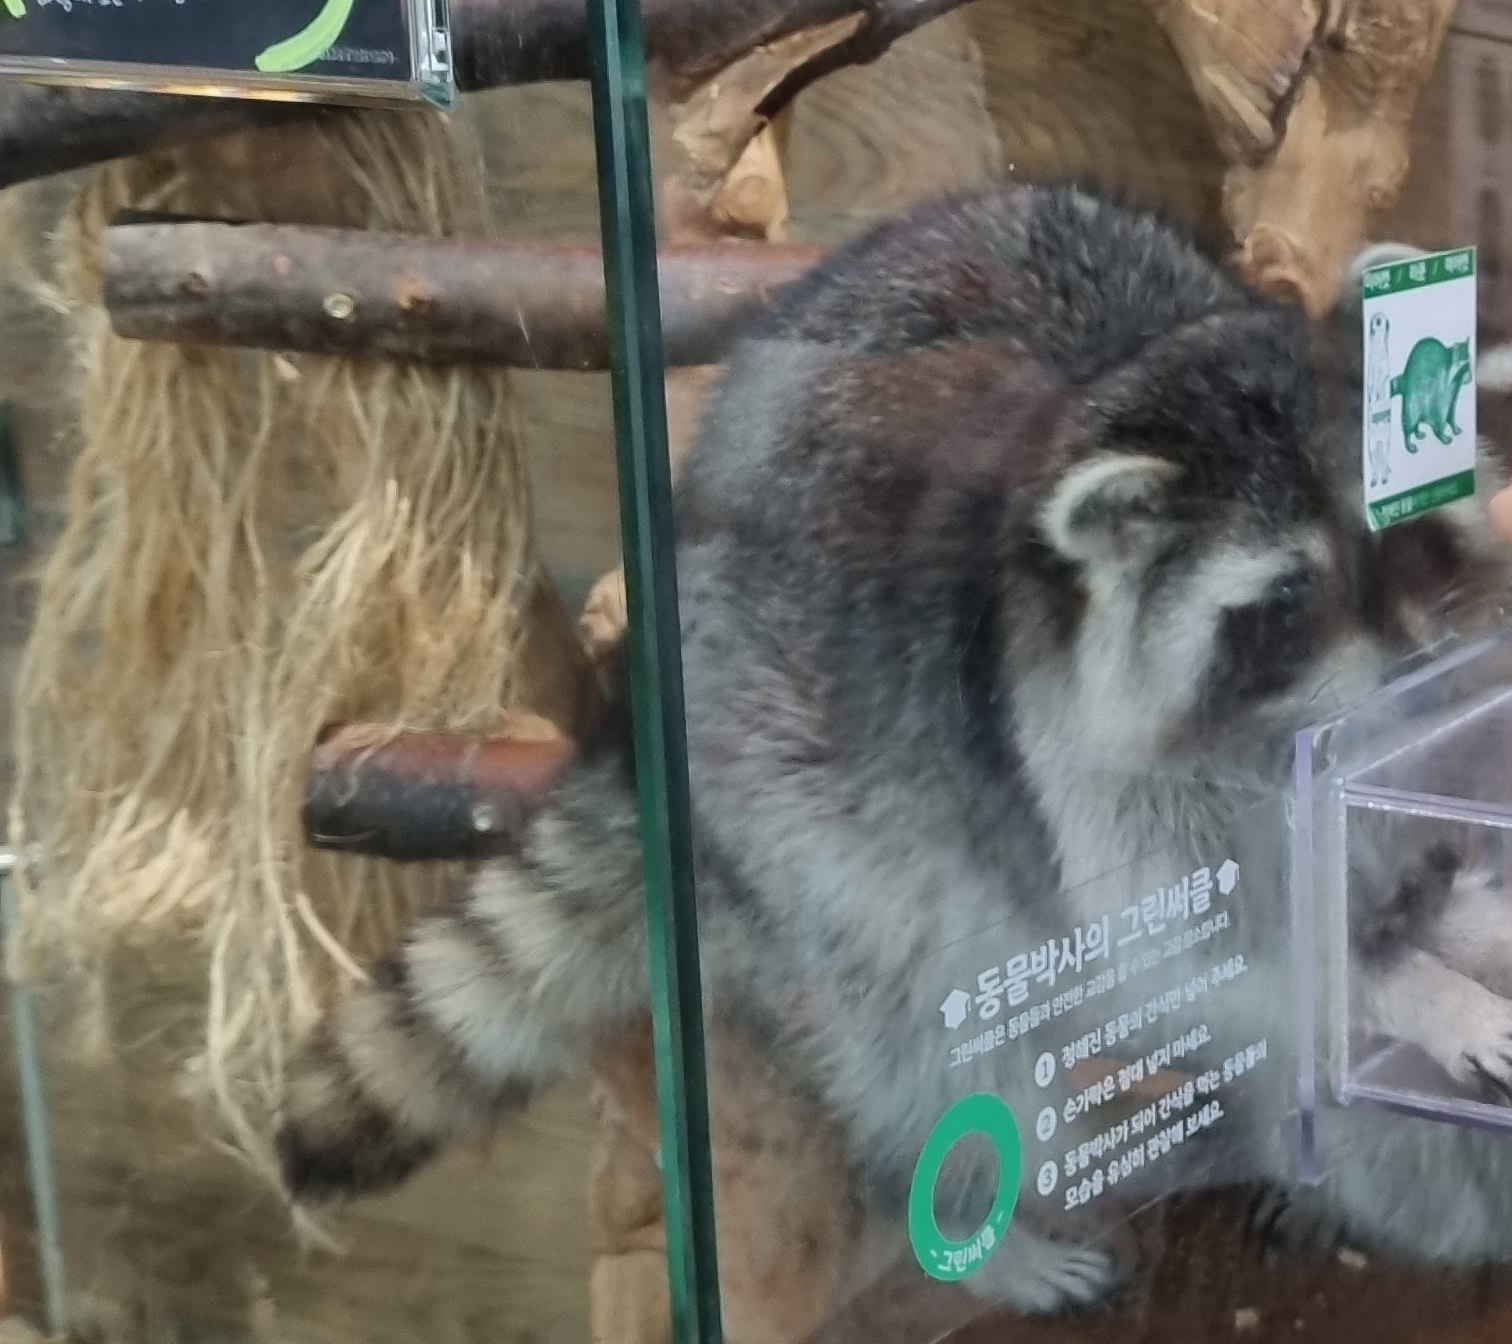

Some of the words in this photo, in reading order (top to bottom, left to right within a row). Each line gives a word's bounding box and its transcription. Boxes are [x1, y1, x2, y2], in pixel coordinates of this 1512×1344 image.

[975, 914, 1110, 1020] 동물박사의
[1117, 866, 1213, 948] 그린써클
[1062, 1075, 1116, 1124] 손가락은
[1064, 1169, 1105, 1211] 모습을
